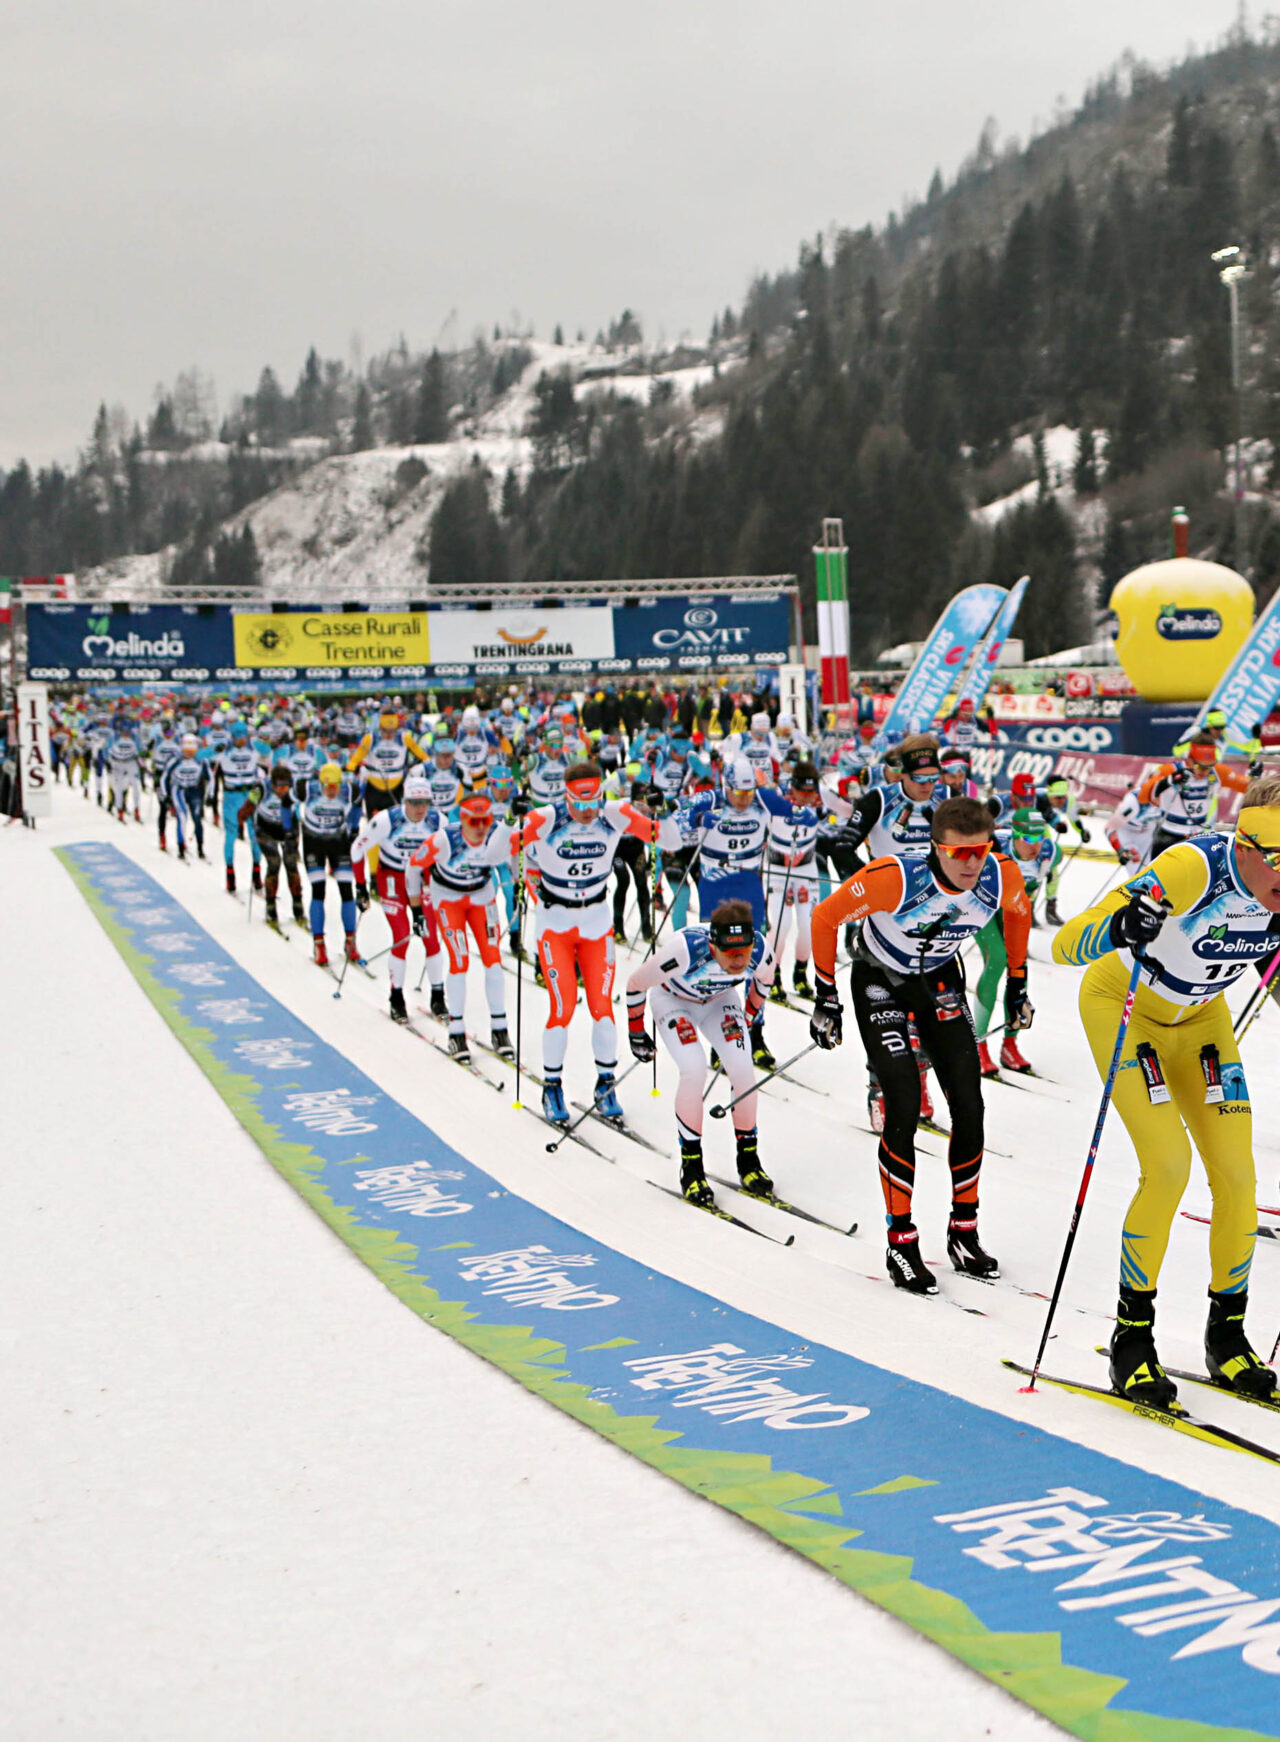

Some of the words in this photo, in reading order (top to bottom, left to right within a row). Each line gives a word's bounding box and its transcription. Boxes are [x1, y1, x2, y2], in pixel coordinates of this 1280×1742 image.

[302, 618, 363, 637] Casse
[366, 617, 421, 635] Rurali
[1158, 615, 1220, 632] Melinda
[82, 631, 185, 657] Melinda
[652, 627, 751, 649] CAVIT
[931, 628, 954, 653] SKI
[321, 642, 406, 660] Trentine
[473, 643, 573, 658] TRENTINGRANA
[898, 652, 940, 715] CLASSICS
[1215, 649, 1266, 715] CLASSI
[913, 669, 954, 719] VISMA
[26, 699, 46, 789] ITAS
[1027, 726, 1112, 752] coop
[1186, 803, 1203, 814] 56
[559, 845, 606, 856] Melinda
[728, 839, 751, 849] 89
[567, 862, 594, 876] 65
[1198, 937, 1280, 953] Melinda
[282, 1088, 379, 1137] TRENTINO
[1217, 1104, 1252, 1116] Koten
[354, 1160, 474, 1218] TRENTINO
[458, 1245, 621, 1311] TRENTINO
[622, 1343, 871, 1431] TRENTINO
[1132, 1405, 1176, 1427] FISCHER
